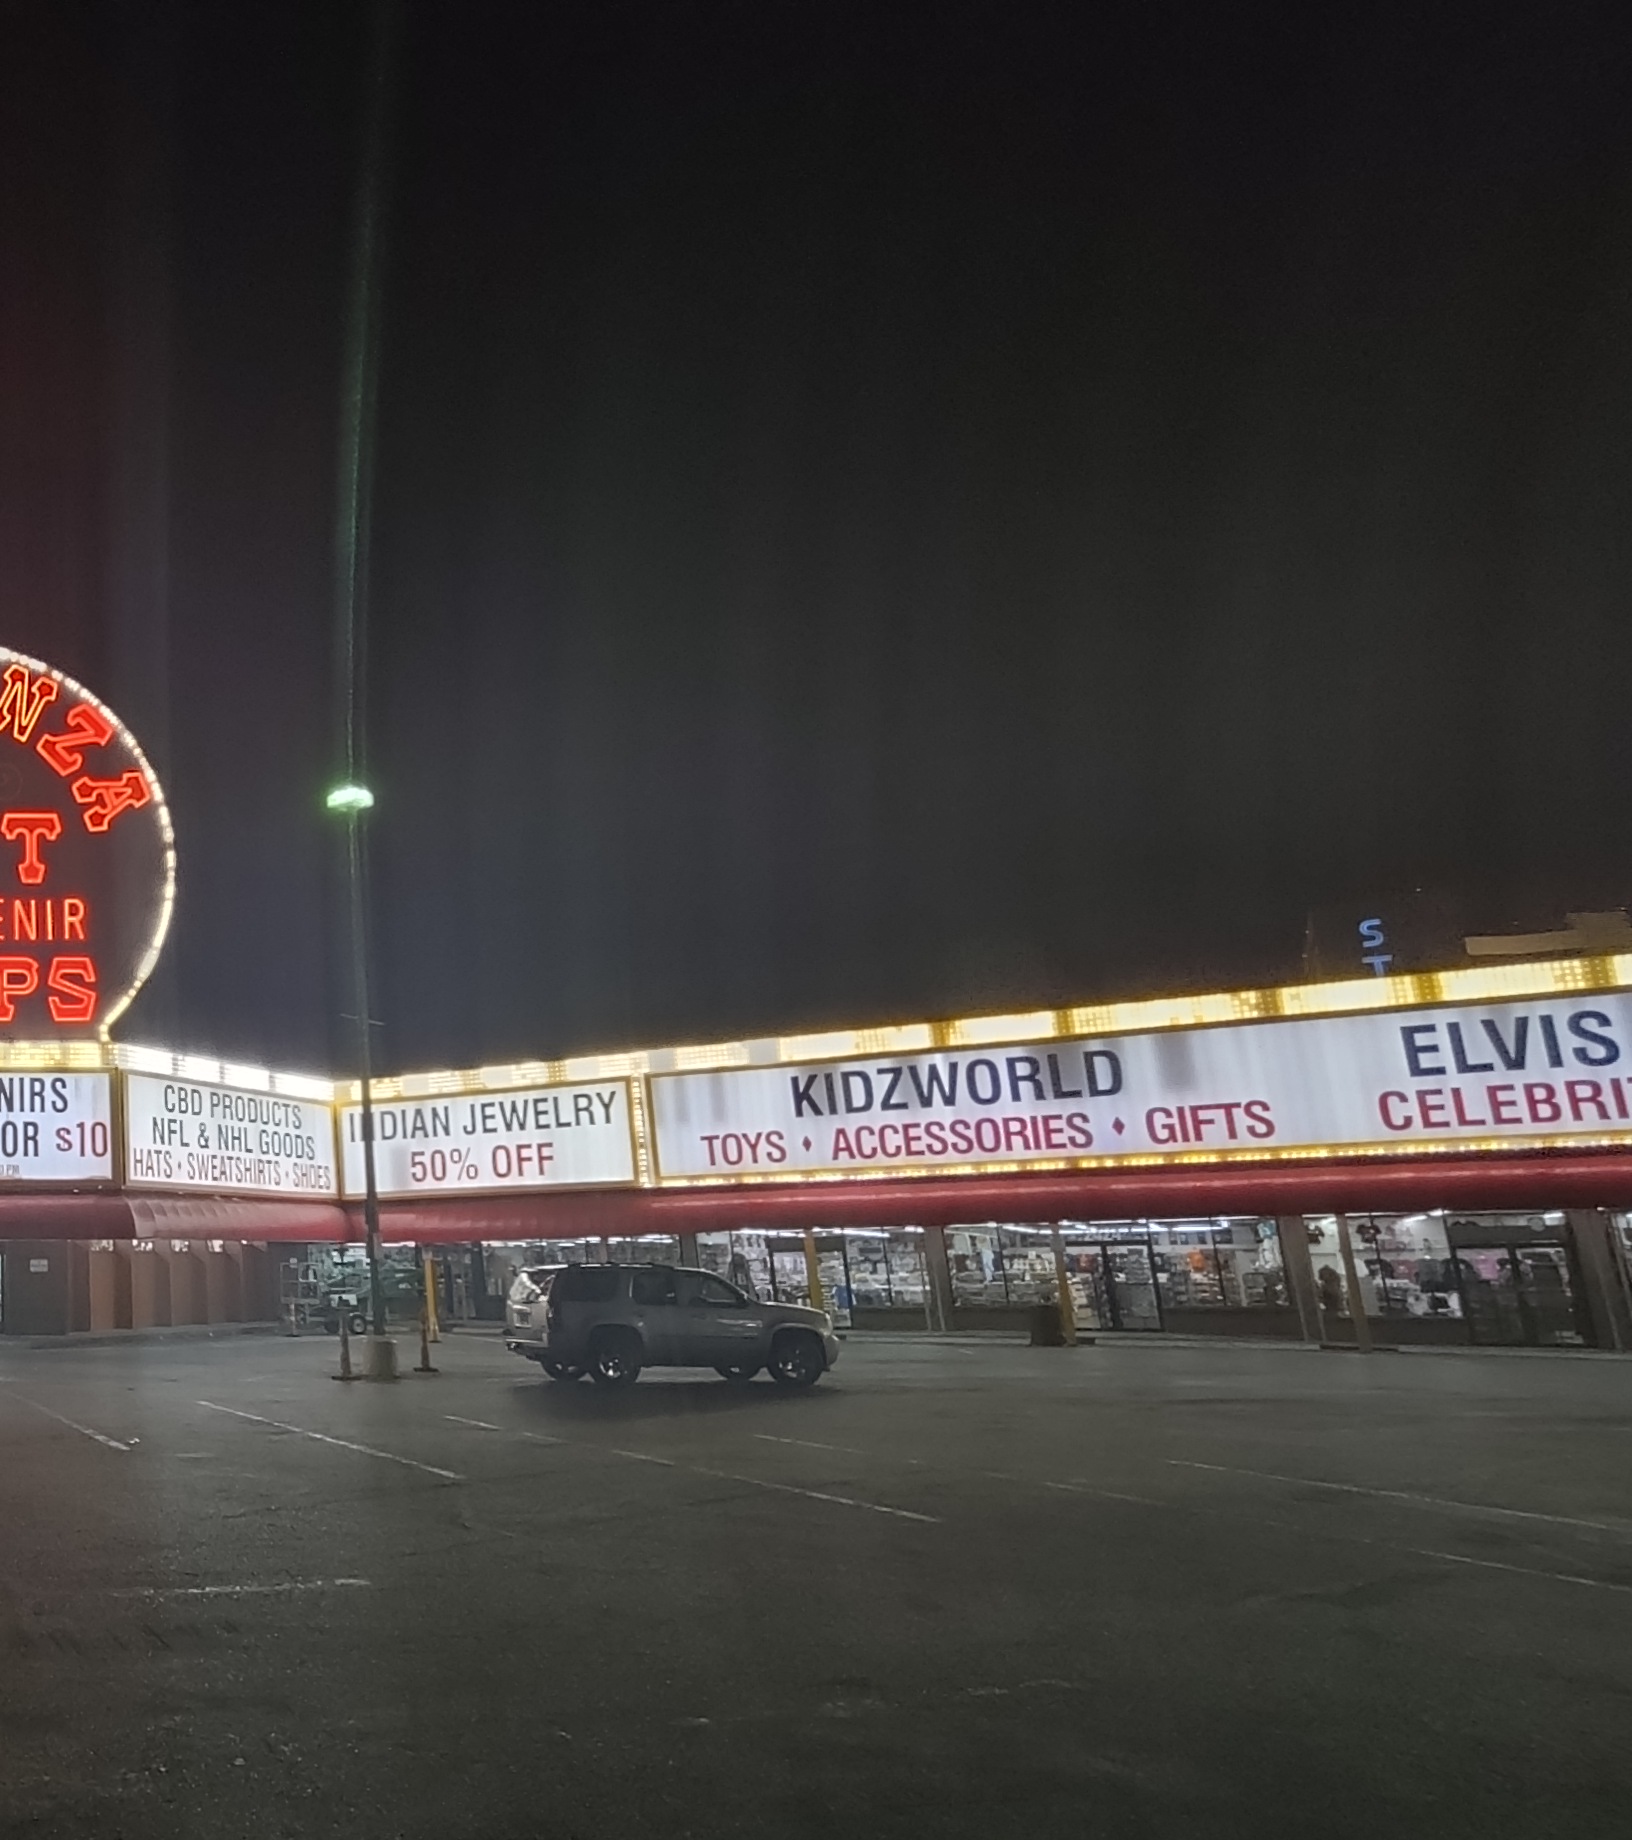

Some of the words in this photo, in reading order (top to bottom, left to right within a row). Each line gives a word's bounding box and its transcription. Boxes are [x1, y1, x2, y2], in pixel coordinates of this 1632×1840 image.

[1400, 1010, 1620, 1077] ELVIS
[164, 1084, 202, 1117] CBD
[210, 1091, 301, 1129] PRODUCTS
[790, 1049, 1123, 1117] KIDZWORLD
[1378, 1077, 1632, 1131] CELEBRI
[55, 1121, 109, 1158] $10
[152, 1116, 188, 1148] NFL
[198, 1123, 210, 1149] &
[217, 1125, 253, 1154] NHL
[259, 1131, 315, 1160] GOODS
[349, 1106, 451, 1142] IDIAN
[462, 1090, 617, 1136] JEWELRY
[700, 1130, 787, 1166] TOYS
[831, 1112, 1093, 1160] ACCESSORIES
[1145, 1100, 1276, 1145] GIFTS
[133, 1149, 173, 1179] HATS
[187, 1153, 282, 1185] SWEATSHIRTS
[293, 1159, 331, 1190] SHOES
[410, 1147, 479, 1182] 50%
[492, 1142, 554, 1178] OFF
